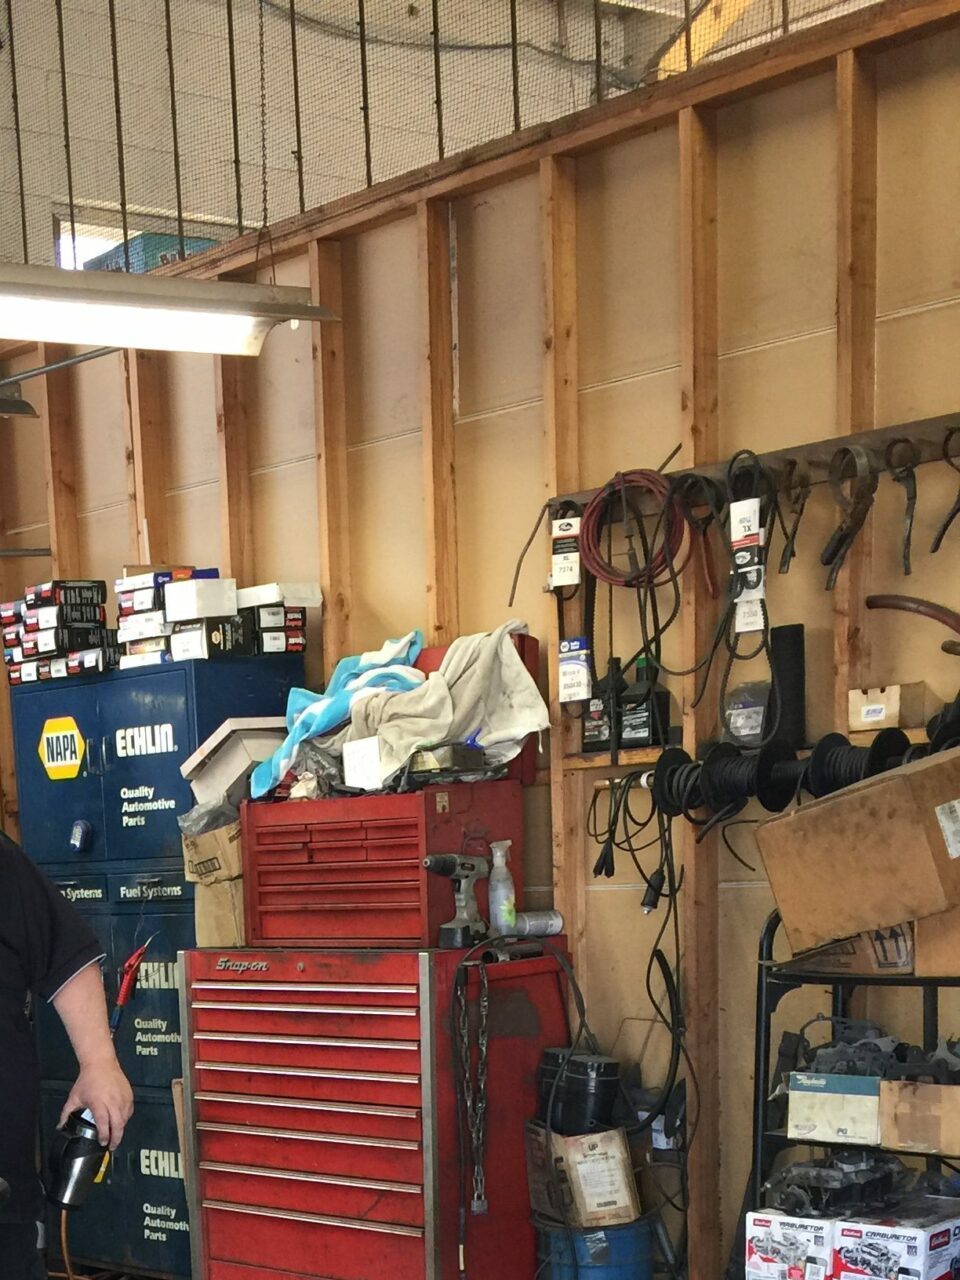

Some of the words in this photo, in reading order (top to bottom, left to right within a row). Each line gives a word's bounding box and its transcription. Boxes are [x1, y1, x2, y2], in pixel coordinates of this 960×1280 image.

[46, 734, 78, 762] NAPA
[120, 786, 155, 800] Quality
[121, 798, 176, 813] Automotive
[122, 816, 145, 827] Parts
[67, 888, 103, 902] Systems
[120, 886, 140, 898] Fuel
[142, 886, 182, 900] Systems
[216, 958, 268, 973] Snap-on
[134, 1018, 168, 1031] Quality
[135, 1031, 182, 1043] Automotiv
[136, 1045, 159, 1056] Parts
[140, 1148, 184, 1179] ECHLI
[142, 1203, 176, 1219] Quality
[144, 1229, 167, 1241] Parts
[865, 1231, 918, 1242] CARBURETOR
